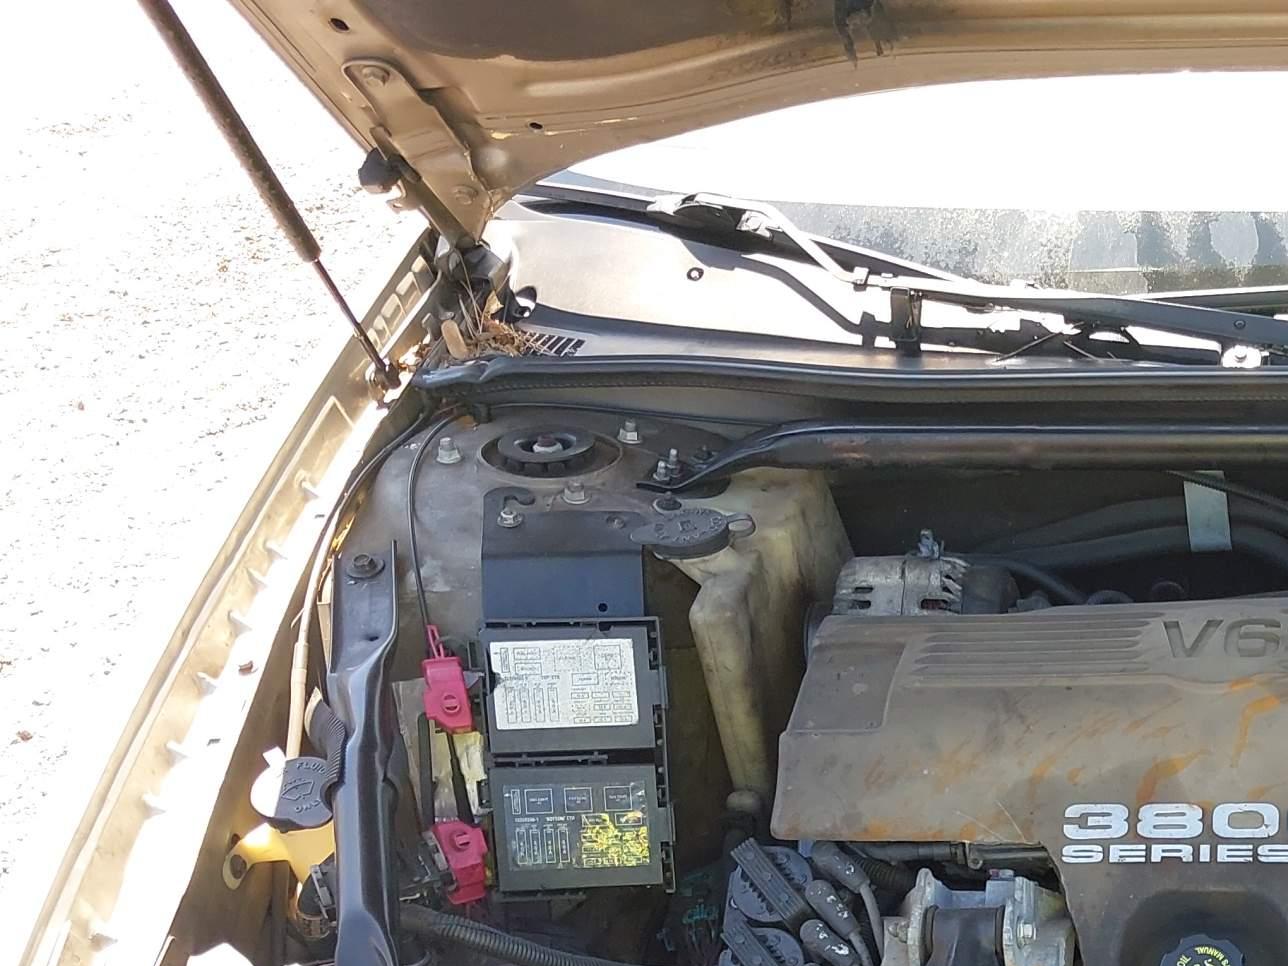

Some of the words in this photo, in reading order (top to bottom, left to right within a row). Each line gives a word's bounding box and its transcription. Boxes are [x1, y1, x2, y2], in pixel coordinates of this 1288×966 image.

[1161, 618, 1281, 658] V6
[296, 762, 327, 775] FLUID
[295, 798, 321, 813] ONLY
[1194, 946, 1225, 961] MANUAL
